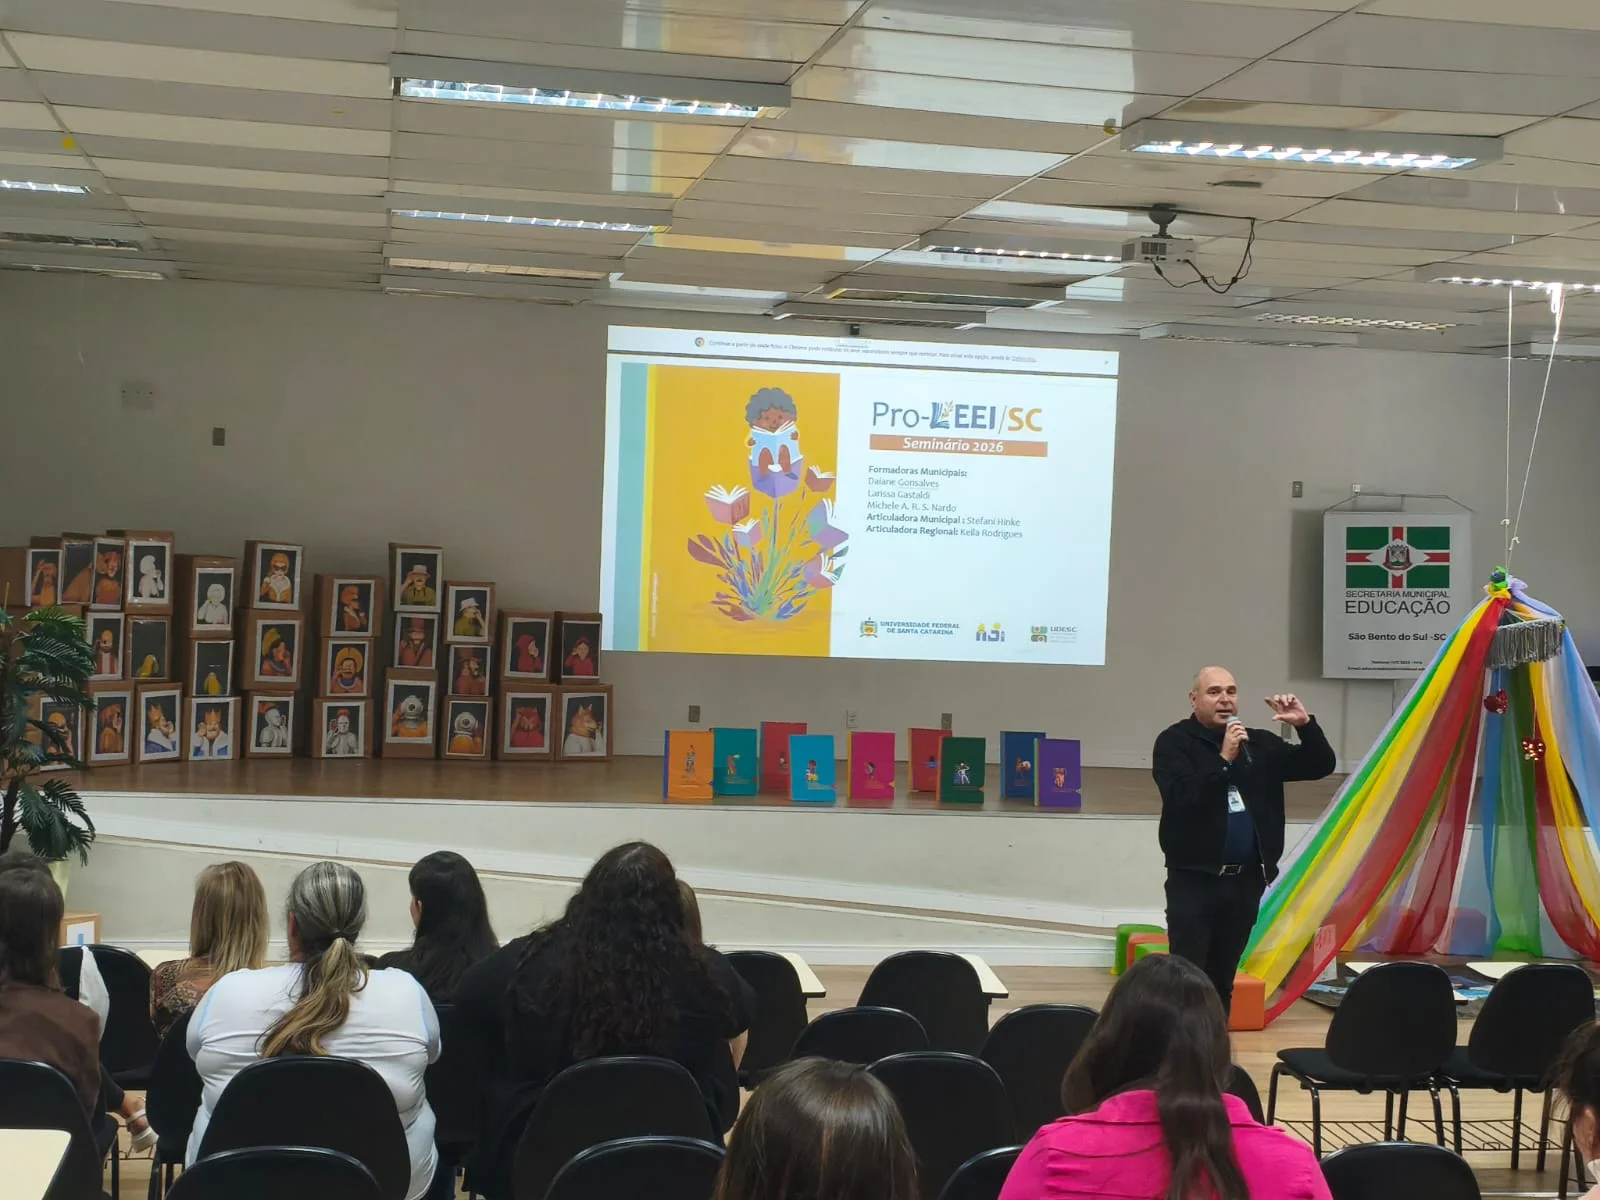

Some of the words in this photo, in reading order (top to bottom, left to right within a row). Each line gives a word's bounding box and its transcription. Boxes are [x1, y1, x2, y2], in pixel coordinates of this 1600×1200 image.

[903, 437, 969, 451] Seminário
[973, 441, 1004, 452] 2026
[868, 465, 918, 475] Formadoras
[920, 468, 968, 478] Municipais:
[867, 477, 896, 486] Daiane
[898, 479, 939, 488] Gonsalves
[867, 489, 895, 498] Larissa
[897, 491, 930, 500] Gastaldi
[867, 501, 900, 510] Michele
[922, 503, 929, 511] S.
[931, 504, 957, 512] Nardo
[866, 513, 918, 522] Articuladora
[920, 515, 961, 525] Municipal
[967, 517, 996, 526] Stefani
[997, 518, 1021, 527] Hinke
[865, 525, 918, 535] Articuladora
[919, 526, 958, 537] Regional:
[960, 528, 980, 537] Keila
[981, 529, 1023, 540] Rodrigues
[1345, 598, 1450, 617] EDUCAÇÃO
